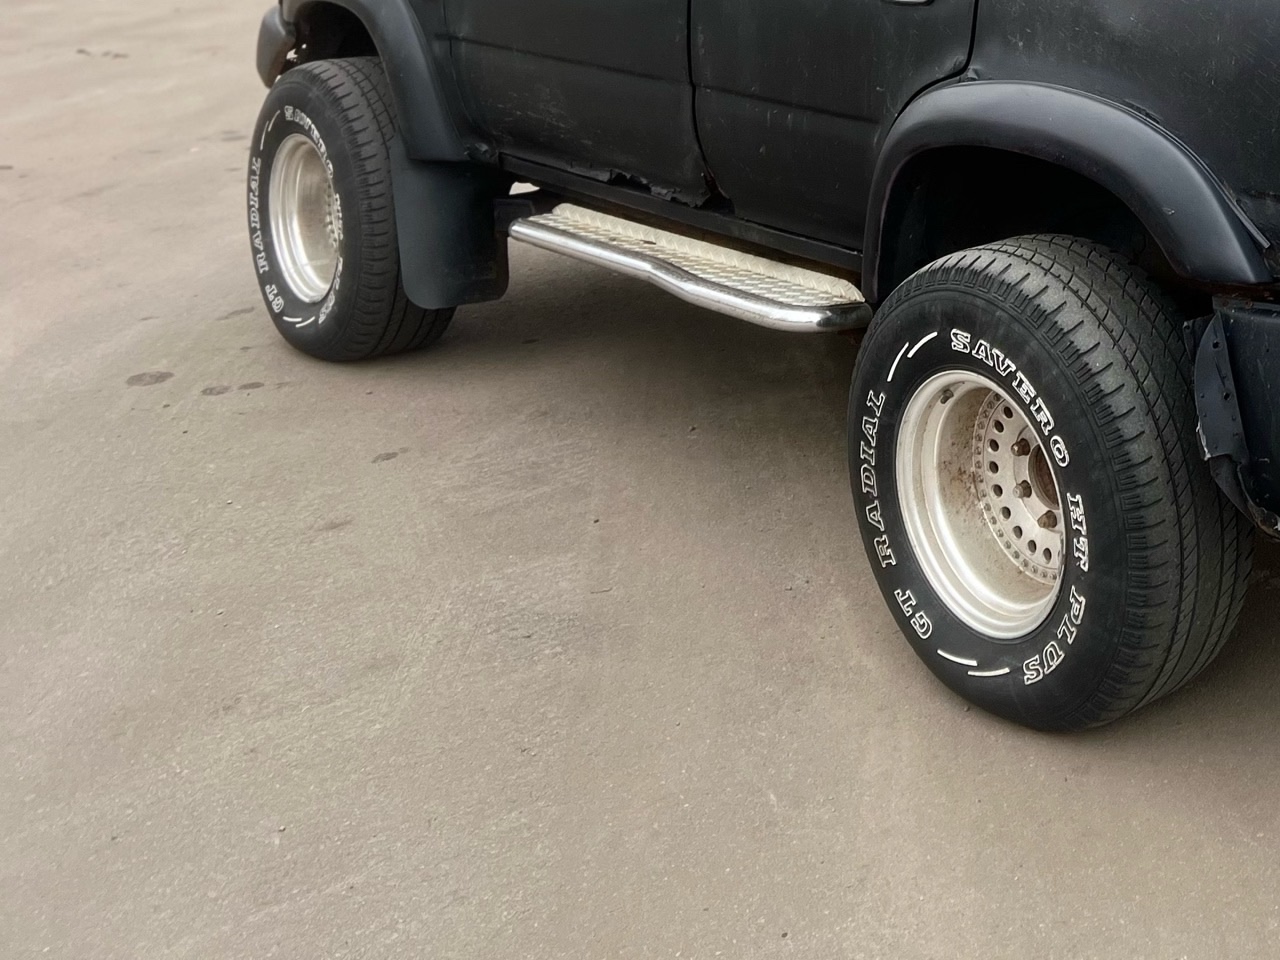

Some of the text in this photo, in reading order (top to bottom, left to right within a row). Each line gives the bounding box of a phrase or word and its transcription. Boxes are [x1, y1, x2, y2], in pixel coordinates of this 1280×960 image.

[265, 284, 284, 313] GT
[861, 390, 933, 639] GT RADIAL
[950, 328, 1089, 685] SAVERO HT PLUS
